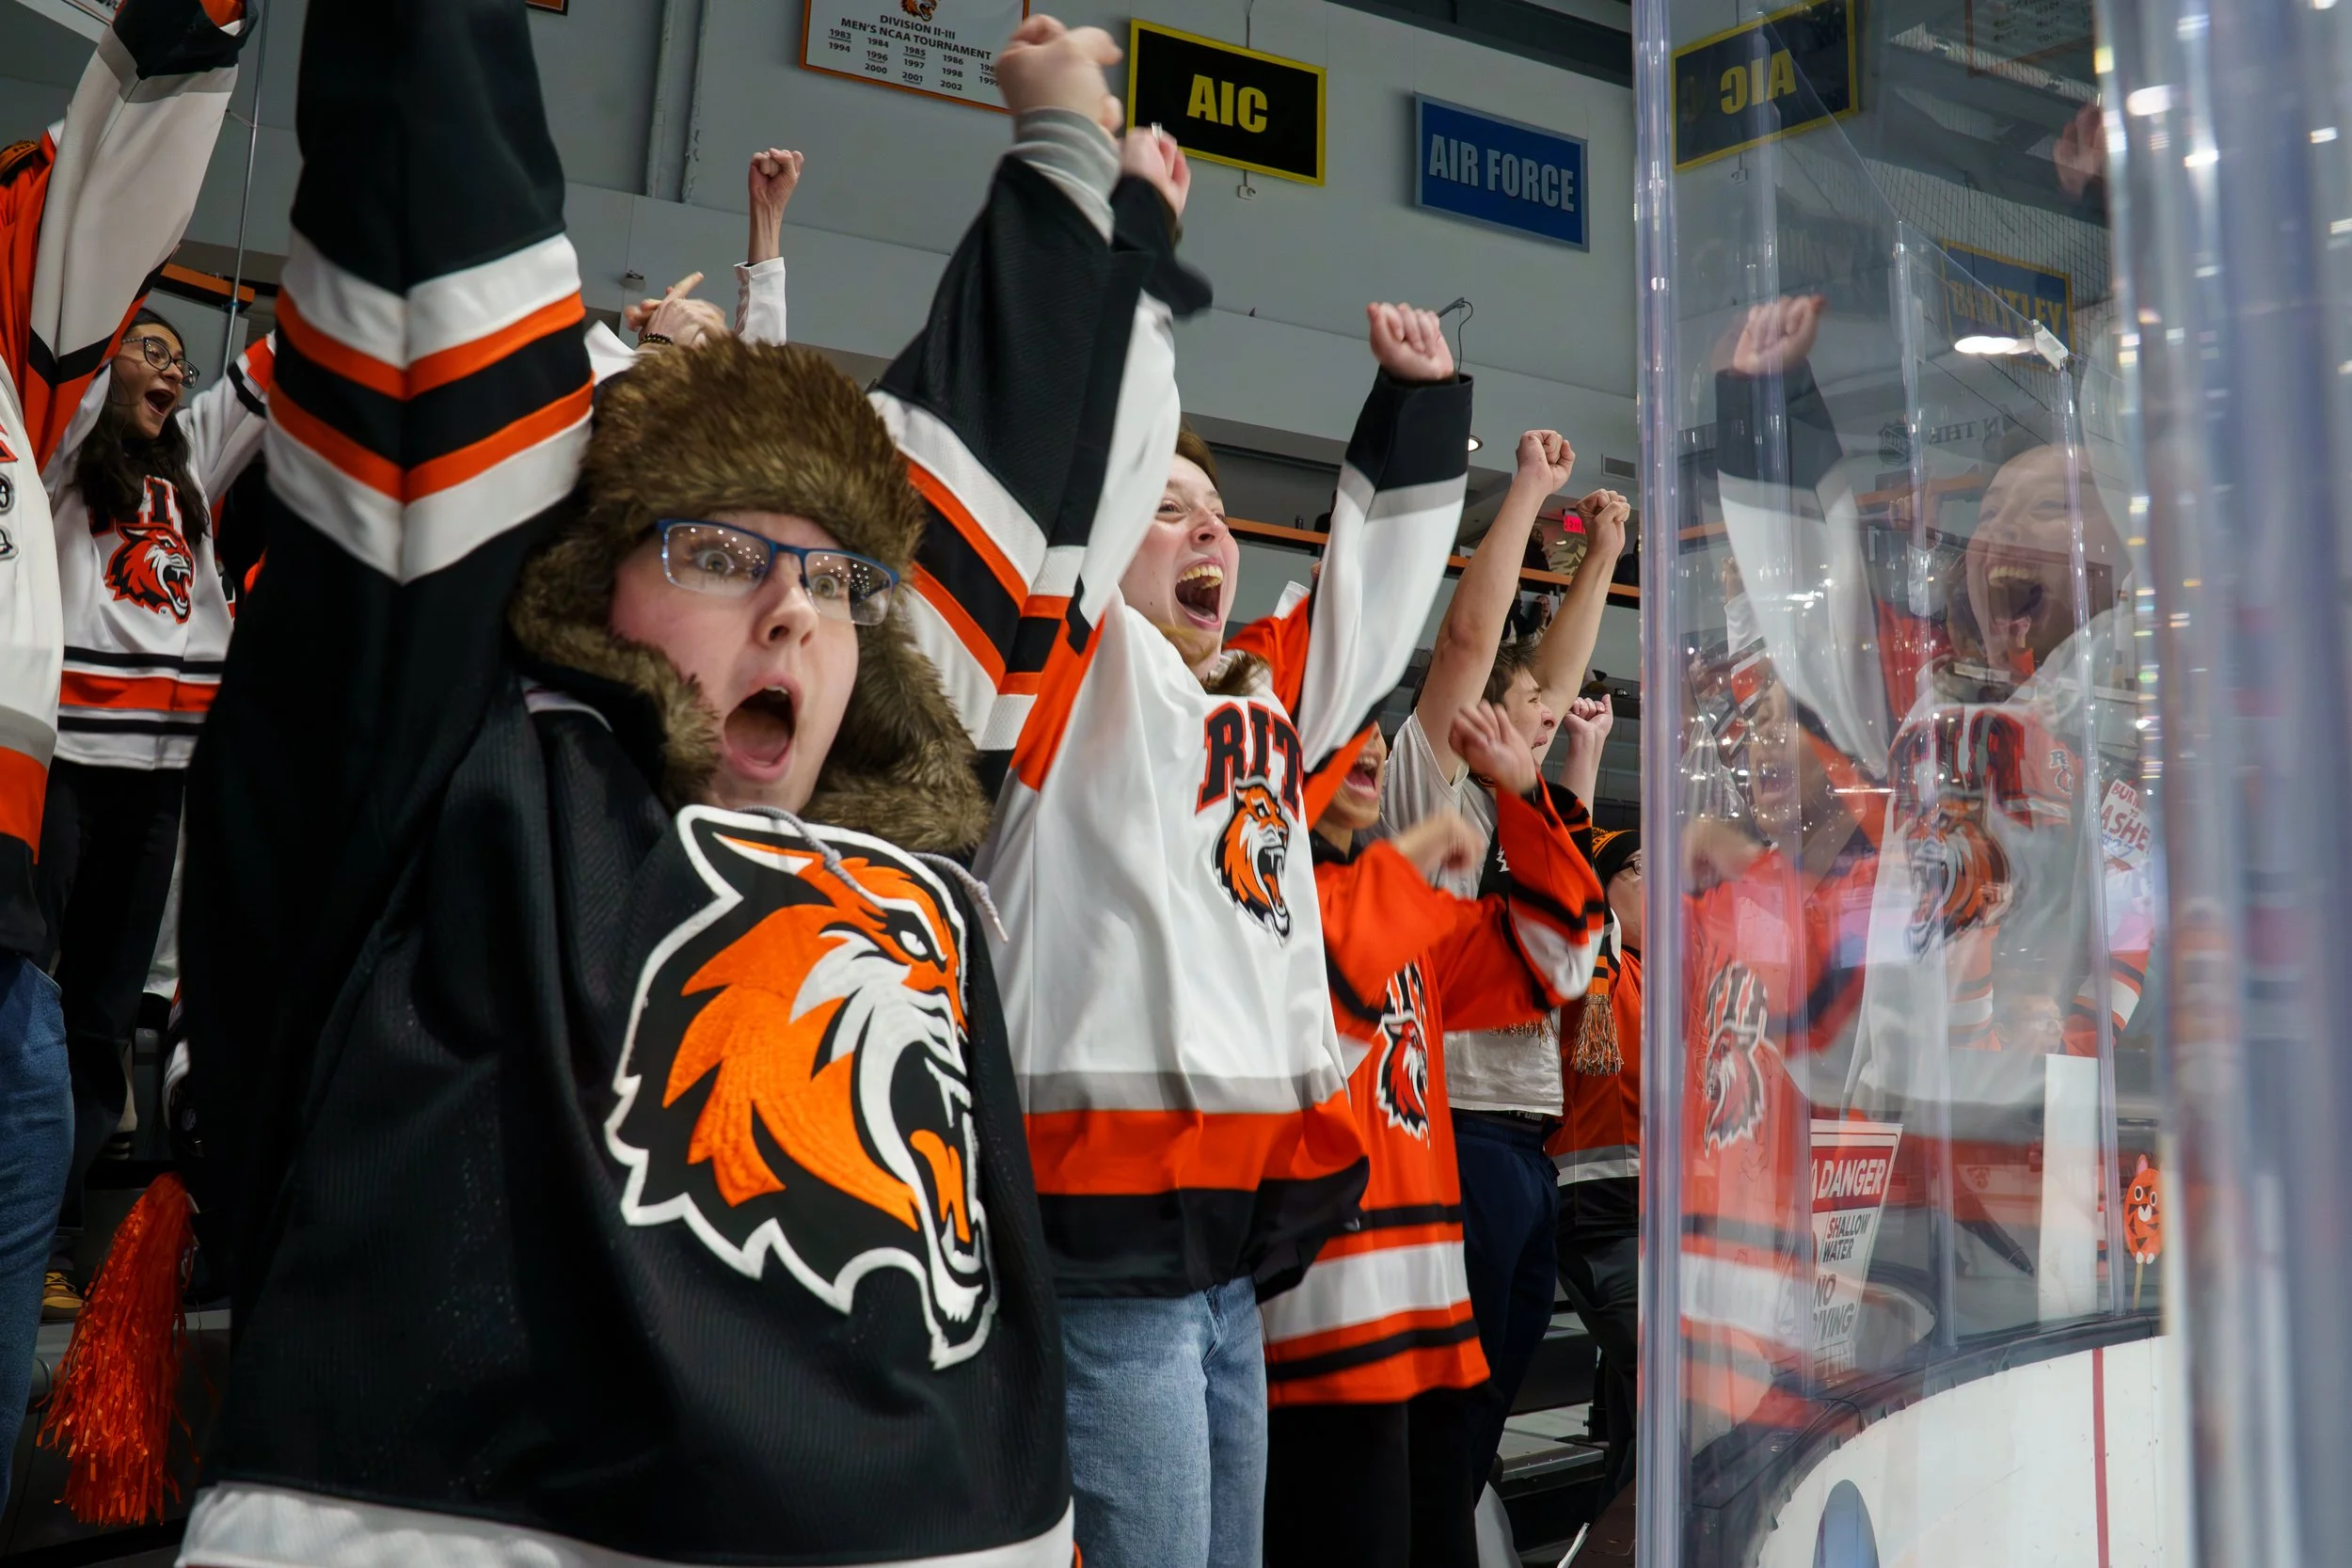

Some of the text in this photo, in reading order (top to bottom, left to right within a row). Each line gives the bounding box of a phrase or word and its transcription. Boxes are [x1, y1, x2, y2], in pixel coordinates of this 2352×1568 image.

[840, 18, 877, 34] MEN'S
[879, 26, 912, 41] NCAA
[913, 34, 993, 60] TOURNAMENT
[880, 15, 956, 40] DIVISION II-III
[828, 41, 850, 53] 1994
[866, 50, 889, 61] 1996
[903, 58, 925, 69] 1997
[942, 67, 963, 78] 1998
[830, 28, 851, 40] 1983
[866, 37, 889, 49] 1984
[904, 45, 927, 56] 1985
[943, 55, 964, 66] 1986
[865, 63, 962, 91] 2000 2001 2002
[1187, 74, 1267, 134] AIC
[1428, 134, 1575, 213] AIR FORCE
[1195, 701, 1304, 826] RIT
[1817, 1159, 1886, 1199] DANGER
[1827, 1213, 1870, 1240] SHALLOW
[1822, 1238, 1854, 1263] WATER
[1814, 1274, 1836, 1307] NO
